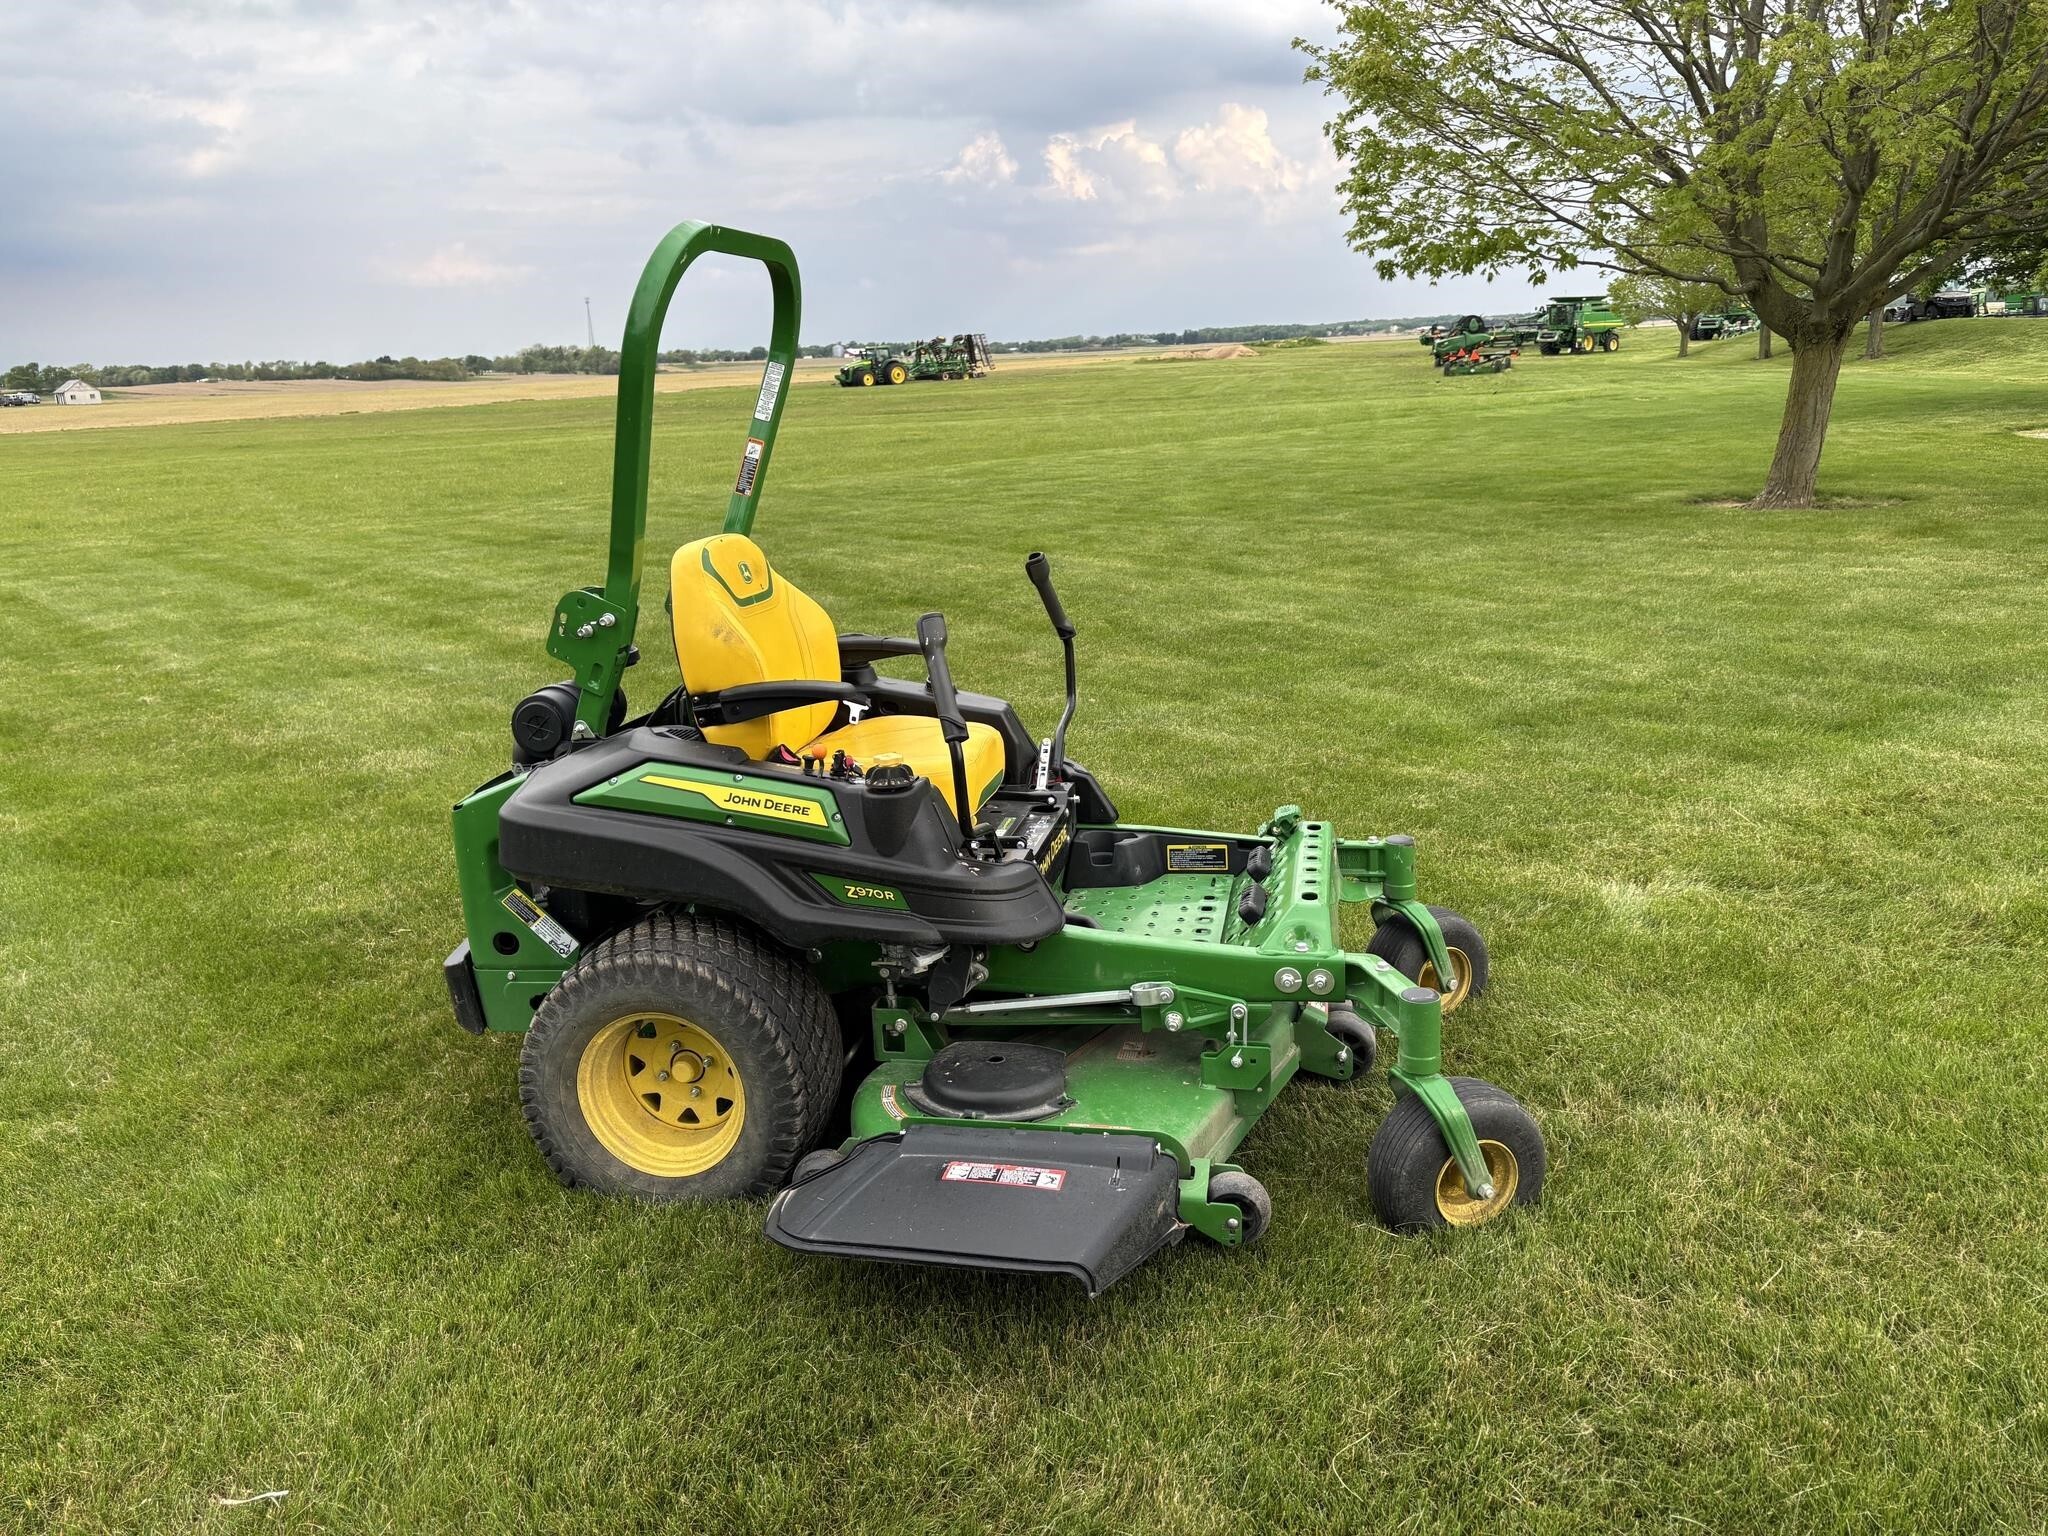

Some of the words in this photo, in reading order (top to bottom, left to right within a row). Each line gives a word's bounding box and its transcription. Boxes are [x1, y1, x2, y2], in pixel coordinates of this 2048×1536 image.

[724, 793, 761, 808] JOHN
[764, 798, 811, 816] DEERE
[844, 885, 895, 901] Z970R
